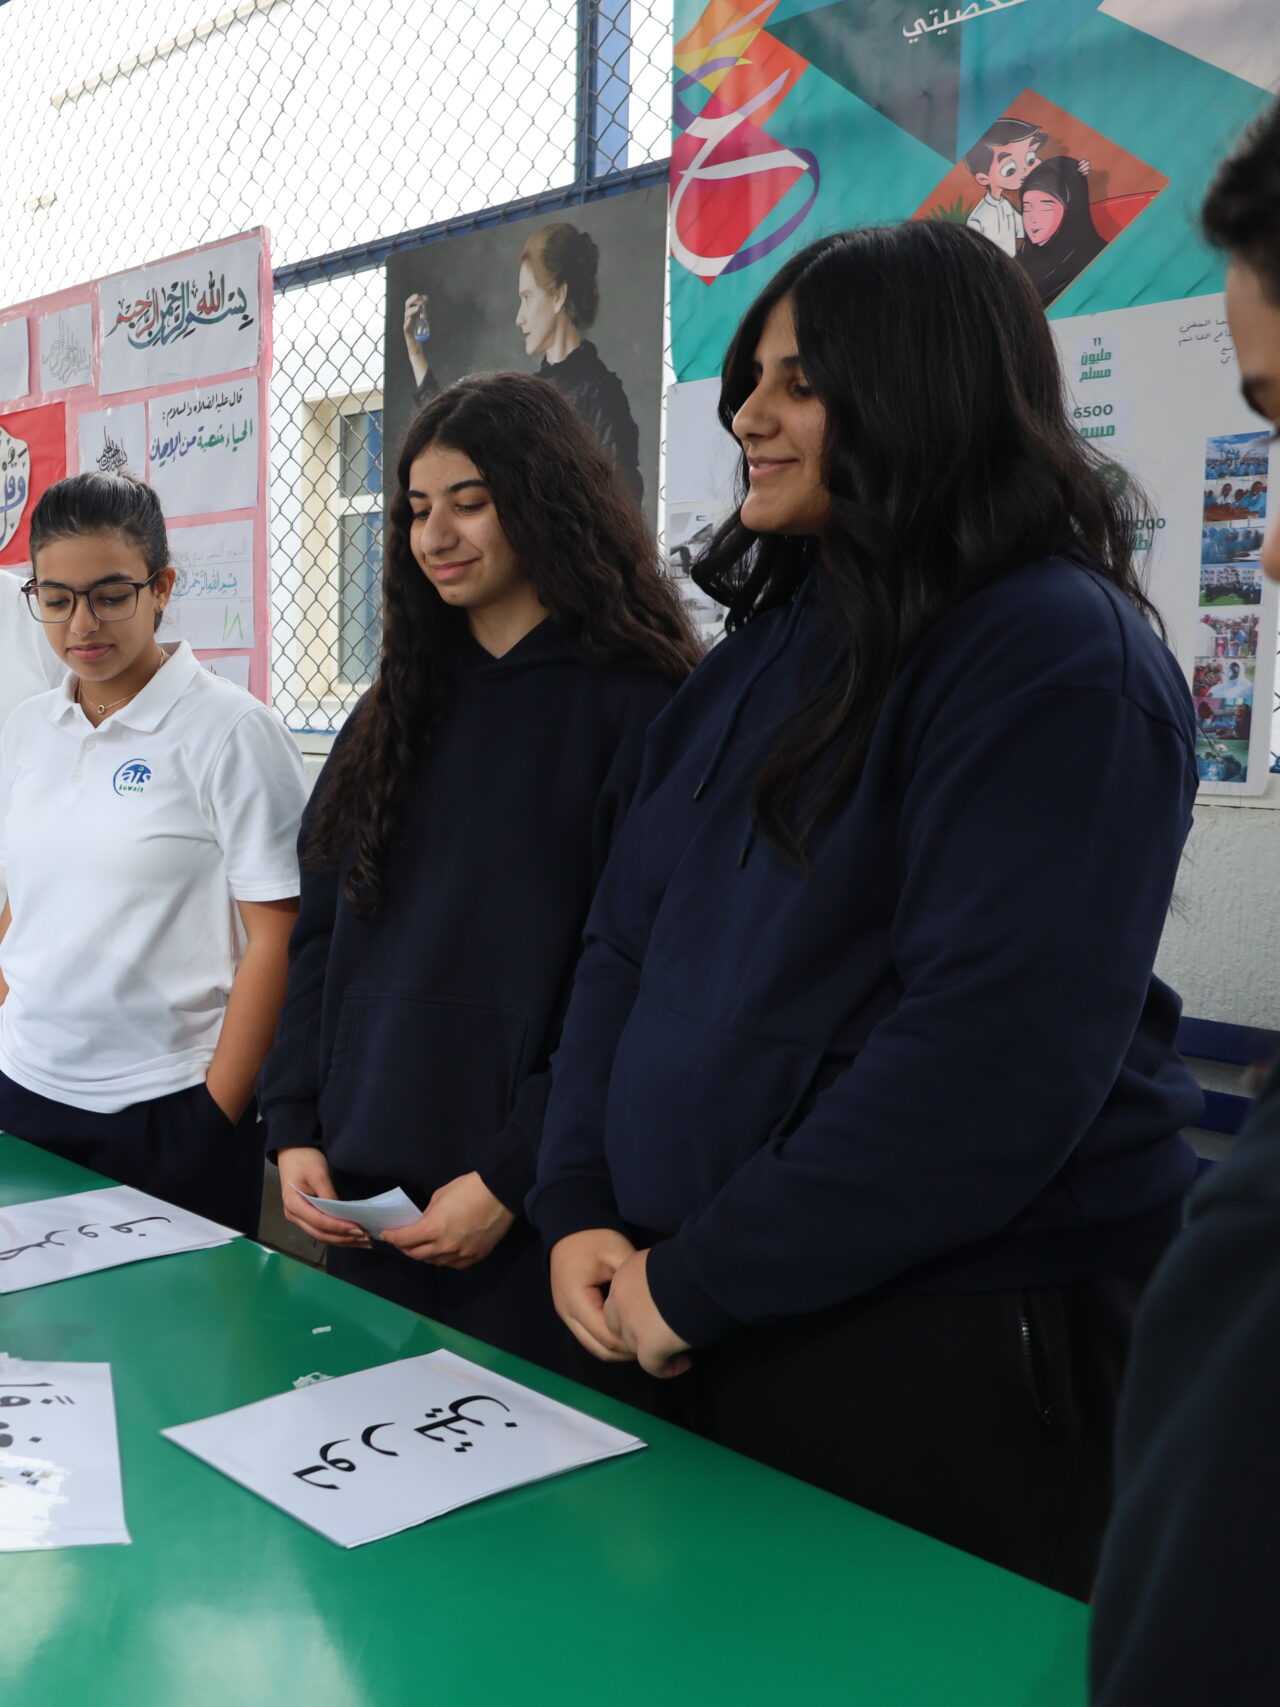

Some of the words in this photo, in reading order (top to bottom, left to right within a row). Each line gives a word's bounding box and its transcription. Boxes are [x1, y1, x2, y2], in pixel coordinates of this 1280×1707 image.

[1080, 348, 1112, 366] مليون
[1078, 367, 1112, 383] مسلم
[1073, 404, 1113, 419] 6500
[179, 435, 197, 457] من
[292, 1395, 518, 1490] دورتين
